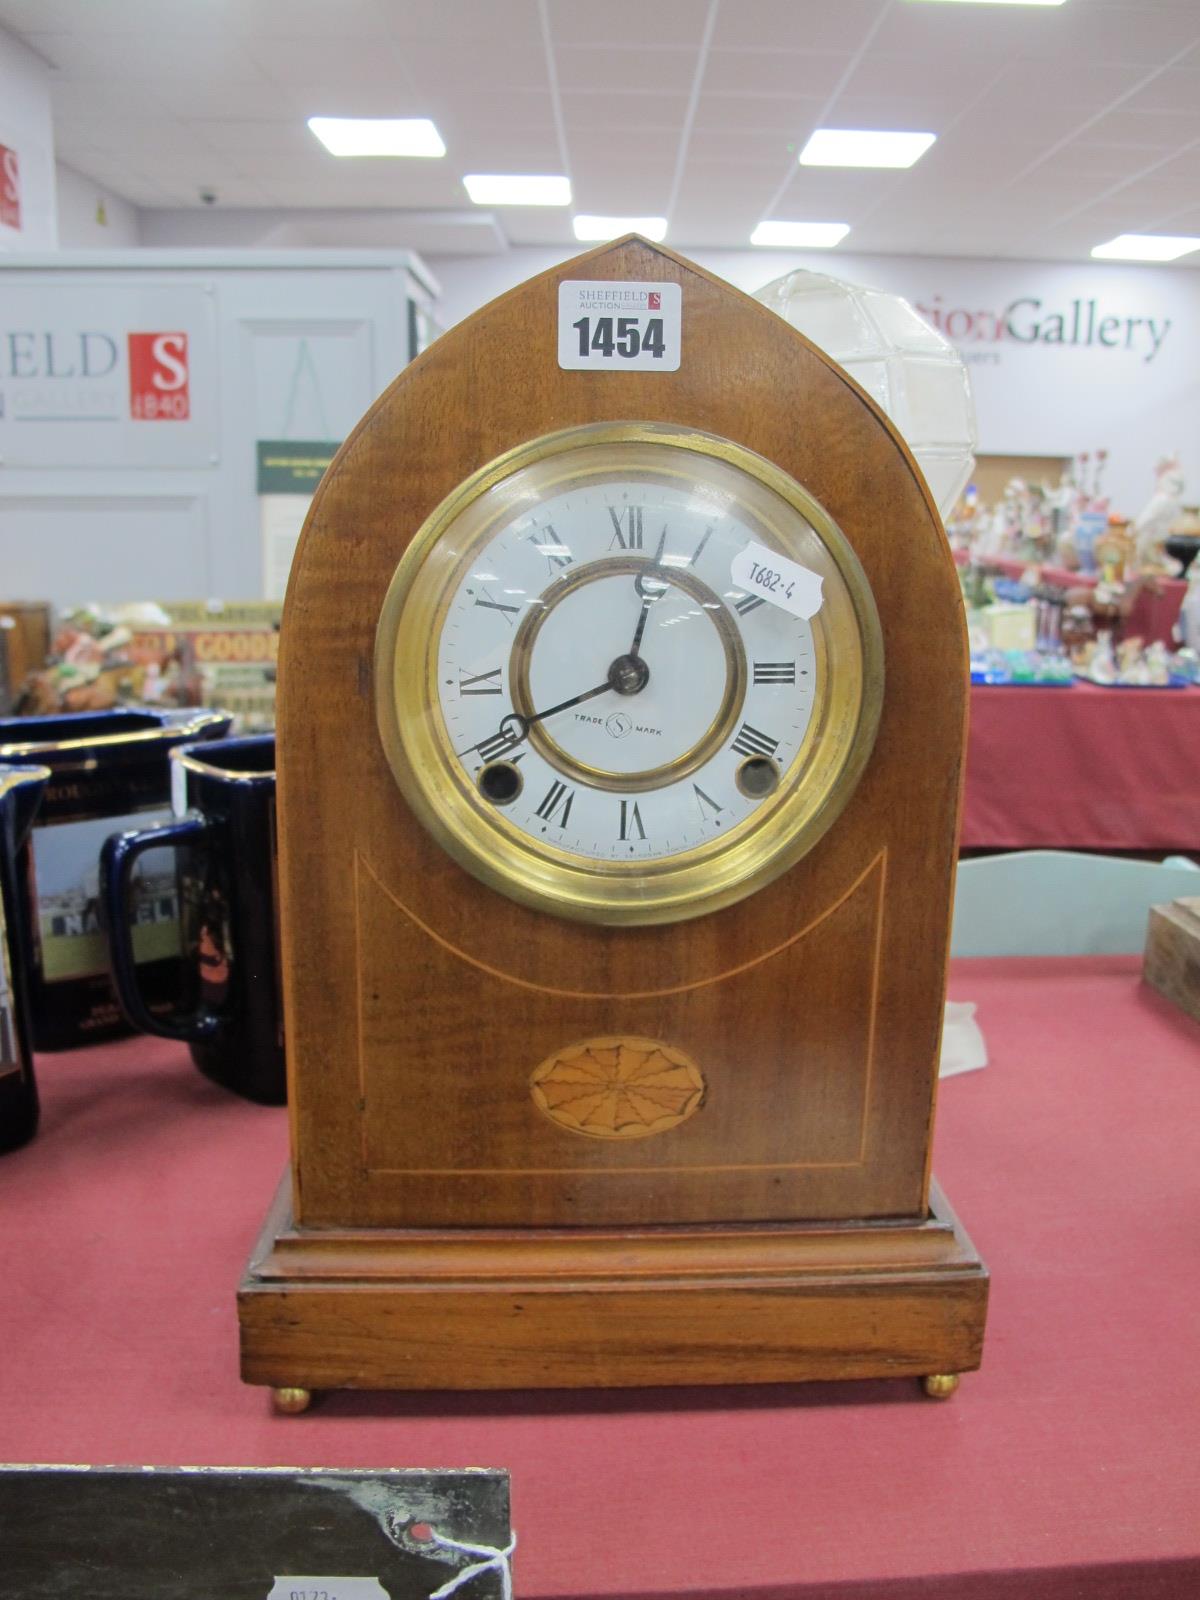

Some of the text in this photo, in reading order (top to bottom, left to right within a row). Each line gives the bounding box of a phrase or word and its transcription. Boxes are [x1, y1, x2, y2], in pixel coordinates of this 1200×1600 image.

[579, 290, 648, 301] SHEFFIELD
[579, 302, 621, 310] AUCTION
[572, 317, 666, 358] 1454
[132, 393, 189, 417] 1840
[607, 505, 643, 551] XII
[528, 525, 574, 576] XI
[753, 660, 796, 687] III
[574, 714, 604, 725] TRADE
[635, 725, 663, 736] MARK
[533, 779, 576, 830] VII
[616, 800, 649, 841] VI
